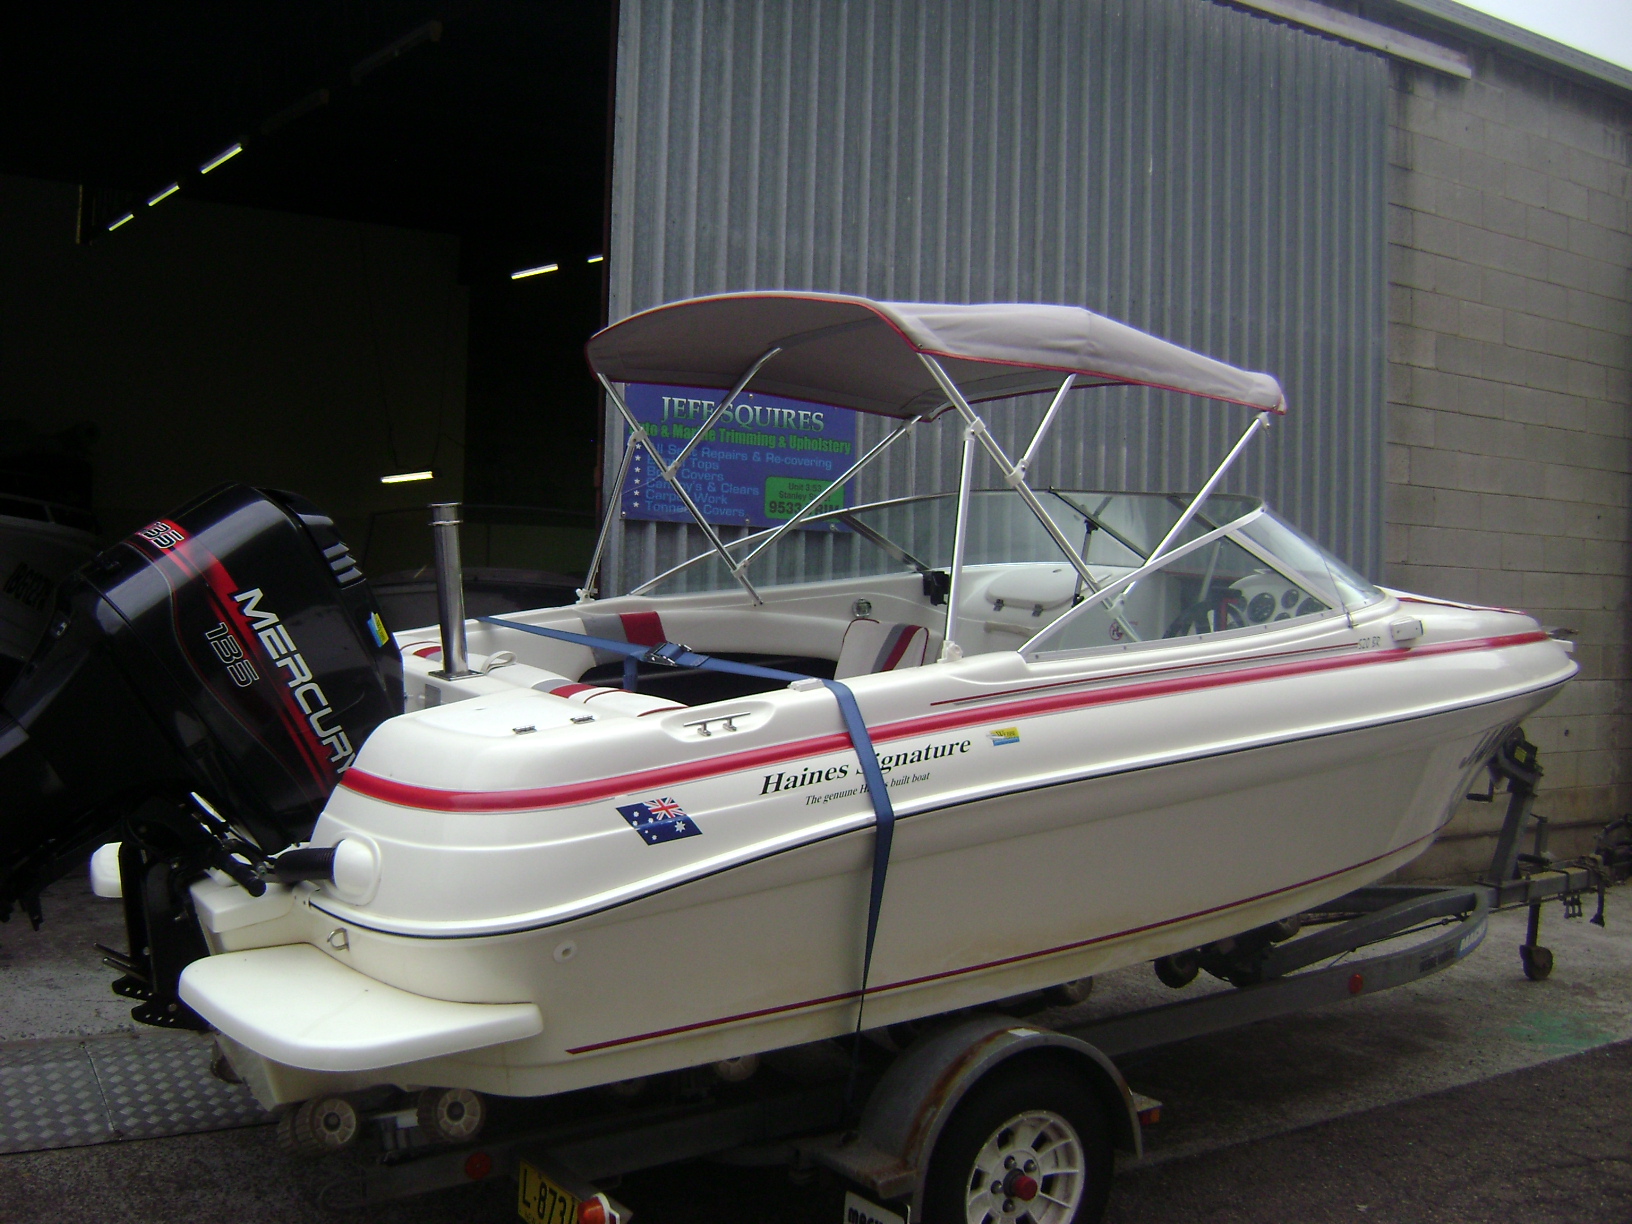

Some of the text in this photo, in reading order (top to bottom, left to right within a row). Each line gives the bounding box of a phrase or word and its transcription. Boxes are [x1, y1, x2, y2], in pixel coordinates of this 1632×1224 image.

[661, 396, 825, 432] JEFF SQUIRES
[629, 421, 658, 437] to
[661, 424, 670, 438] &
[719, 428, 776, 449] Trimming
[778, 435, 786, 448] &
[789, 434, 852, 455] Upholstery
[690, 457, 719, 471] Tops
[701, 447, 748, 462] Repairs
[752, 451, 761, 462] &
[766, 452, 832, 471] Re-covering
[681, 468, 724, 482] Covers
[694, 493, 727, 505] Work
[707, 482, 716, 492] &
[721, 483, 760, 496] Clears
[703, 504, 745, 517] Covers
[205, 621, 260, 688] 135
[758, 739, 972, 796] Haines gnature
[805, 795, 822, 806] The
[822, 788, 858, 804] genuine
[890, 775, 910, 788] built
[911, 772, 931, 784] boat
